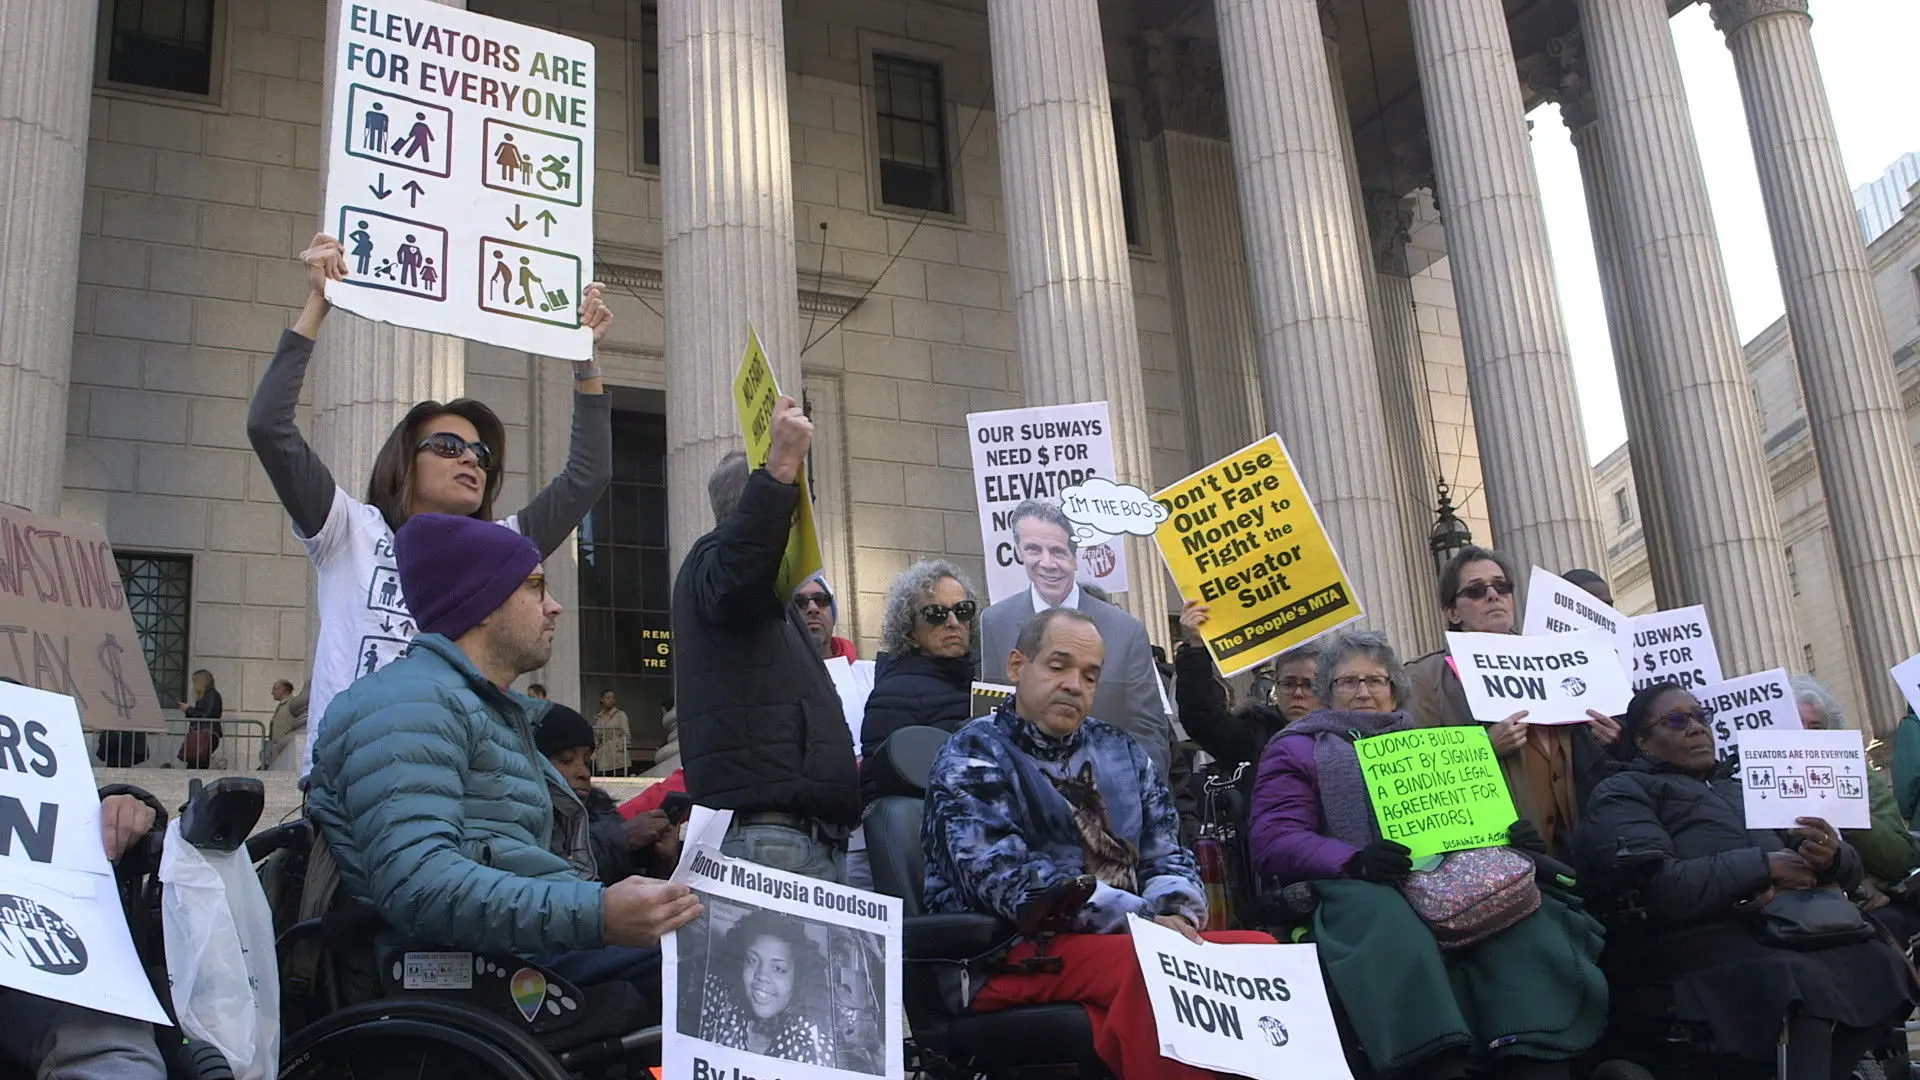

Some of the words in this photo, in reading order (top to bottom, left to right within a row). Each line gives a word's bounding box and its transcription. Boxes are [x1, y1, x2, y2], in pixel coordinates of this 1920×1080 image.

[351, 4, 520, 73] ELEVATORS
[529, 51, 587, 89] ARE
[347, 43, 409, 86] FOR
[419, 62, 587, 128] EVERYONE
[978, 426, 1014, 444] OUR
[1020, 419, 1102, 441] SUBWAYS
[986, 446, 1032, 467] NEED
[1038, 445, 1049, 467] $
[1054, 443, 1088, 462] FOR
[1222, 452, 1273, 484] Use
[1092, 499, 1120, 516] THE
[1120, 500, 1162, 518] BOSS
[1174, 502, 1218, 534] Our
[1221, 473, 1280, 511] Fare
[1181, 504, 1264, 556] Money
[1271, 498, 1291, 513] to
[1194, 531, 1261, 574] Fight
[1263, 522, 1293, 543] the
[1199, 544, 1302, 603] Elevator
[1237, 572, 1292, 608] Suit
[1215, 635, 1243, 651] The
[1243, 606, 1308, 640] People's
[1307, 589, 1340, 611] MTA
[1554, 592, 1574, 611] OUR
[1576, 602, 1616, 634] SUBWAYS
[657, 643, 669, 655] 6
[1633, 622, 1702, 648] UBWAYS
[1472, 650, 1588, 672] ELEVATORS
[1643, 652, 1656, 673] $
[1659, 647, 1694, 666] FOR
[1482, 674, 1547, 700] NOW
[1715, 719, 1731, 742] $
[1733, 709, 1774, 731] FOR
[1362, 732, 1425, 760] CUOMO:
[1745, 750, 1787, 759] ELEVATORS
[1789, 750, 1803, 759] ARE
[1805, 750, 1820, 759] FOR
[1821, 750, 1860, 759] EVERYONE
[1367, 756, 1414, 781] TRUST
[1419, 752, 1437, 772] BY
[1440, 746, 1489, 766] SIGNING
[1378, 785, 1388, 800] A
[1394, 772, 1456, 796] BINDING
[1459, 765, 1493, 782] LEGAL
[1382, 788, 1467, 821] AGREEMENT
[1472, 783, 1500, 802] FOR
[1387, 808, 1474, 840] ELEVATORS!
[689, 850, 728, 882] Honor
[730, 865, 809, 904] Malaysia
[813, 886, 888, 922] Goodson
[0, 906, 78, 939] OPLE'S
[12, 896, 45, 916] THE
[1157, 951, 1291, 1001] ELEVATORS
[1169, 985, 1244, 1040] NOW
